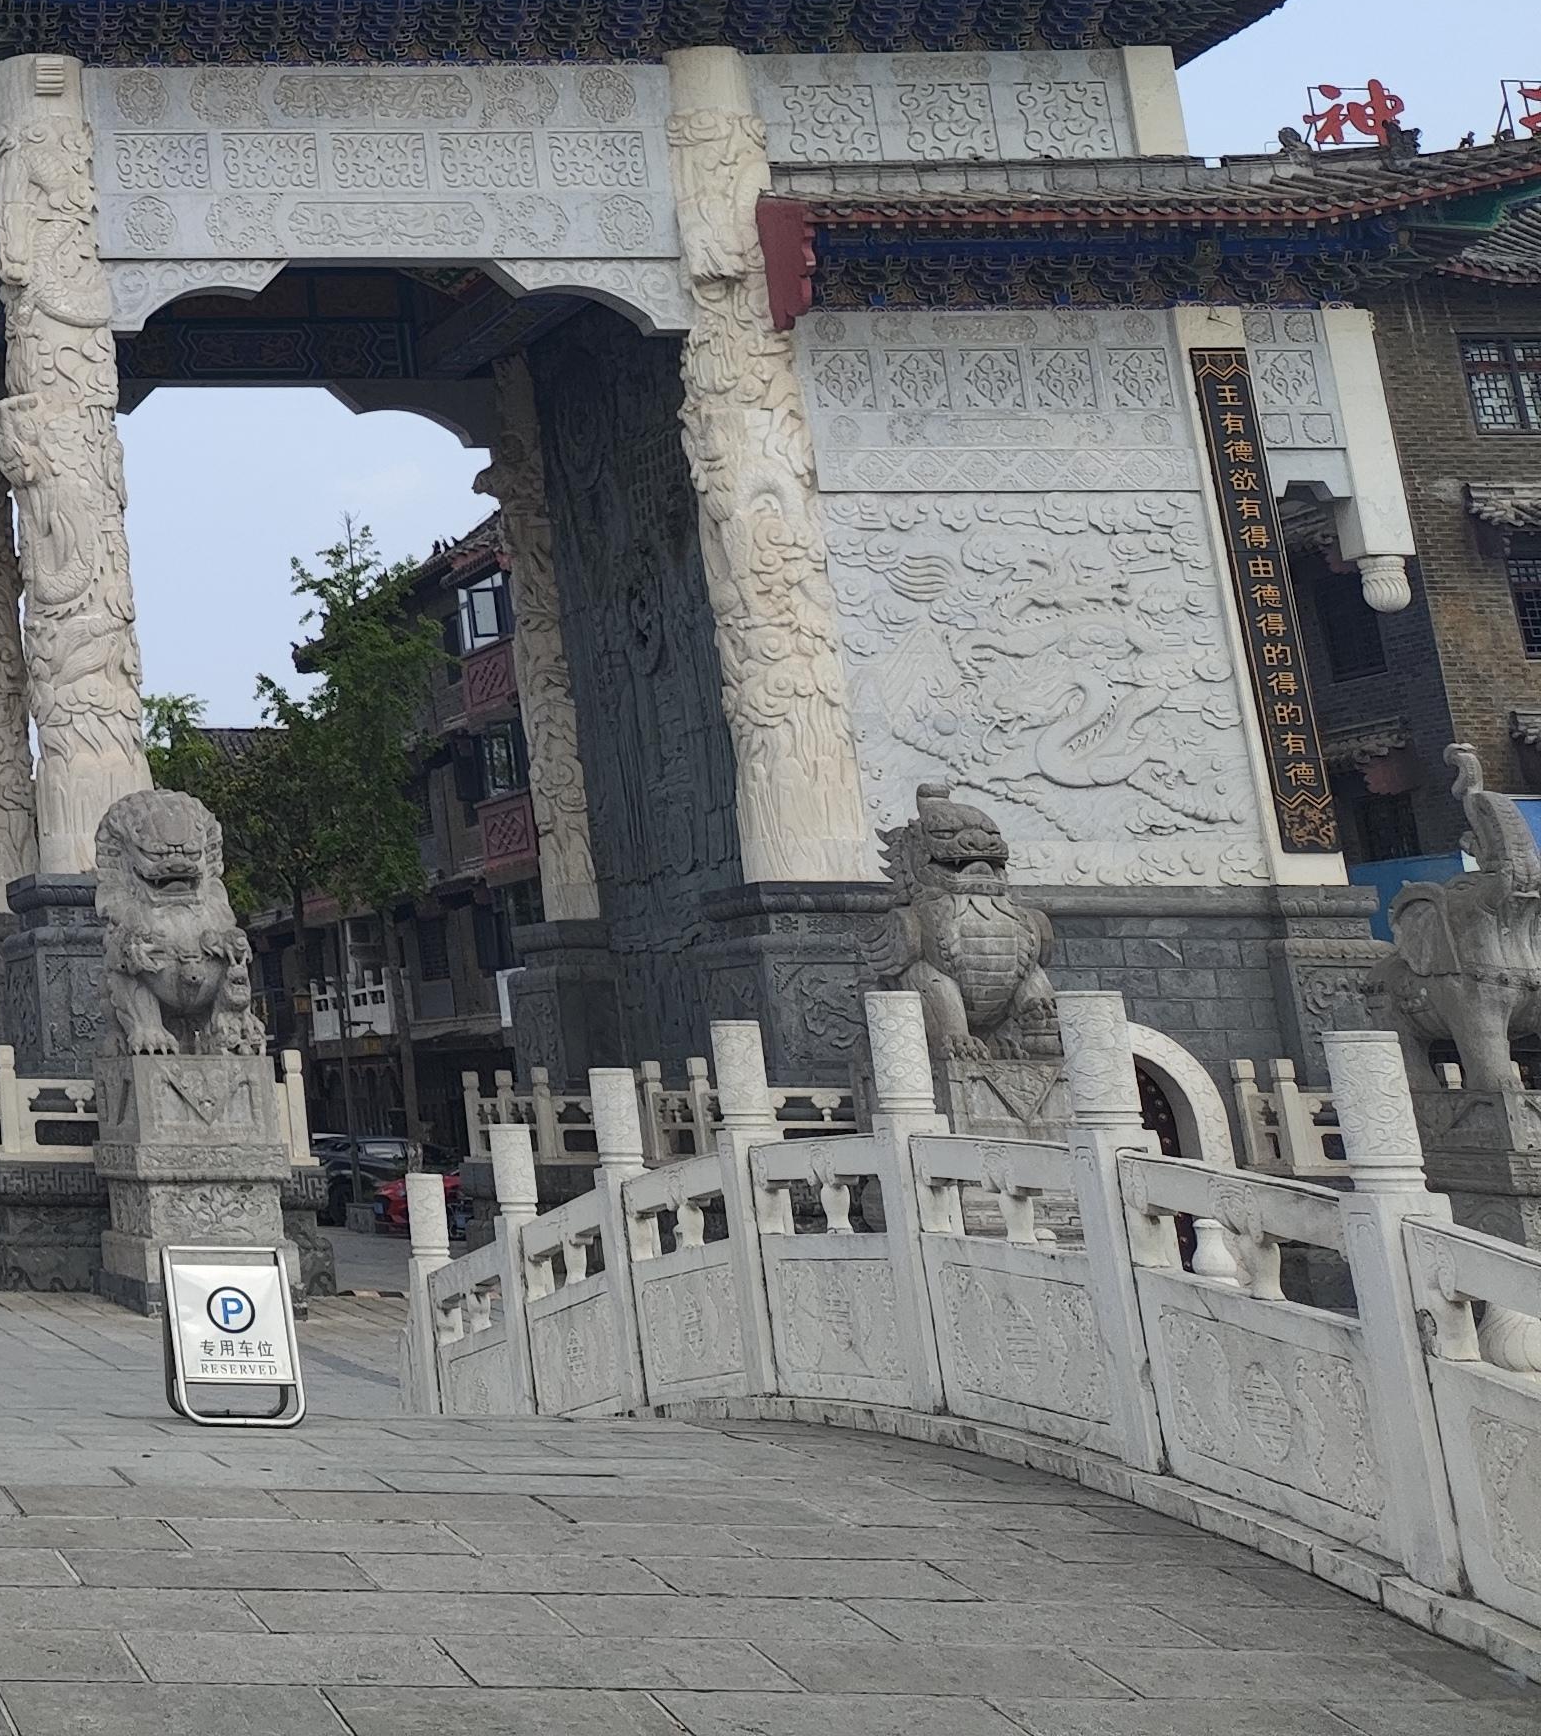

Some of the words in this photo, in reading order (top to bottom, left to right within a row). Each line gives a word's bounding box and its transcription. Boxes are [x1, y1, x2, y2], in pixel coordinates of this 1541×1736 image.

[221, 1297, 244, 1325] P
[200, 1339, 275, 1358] 专用车位
[201, 1363, 278, 1376] RESERVED
